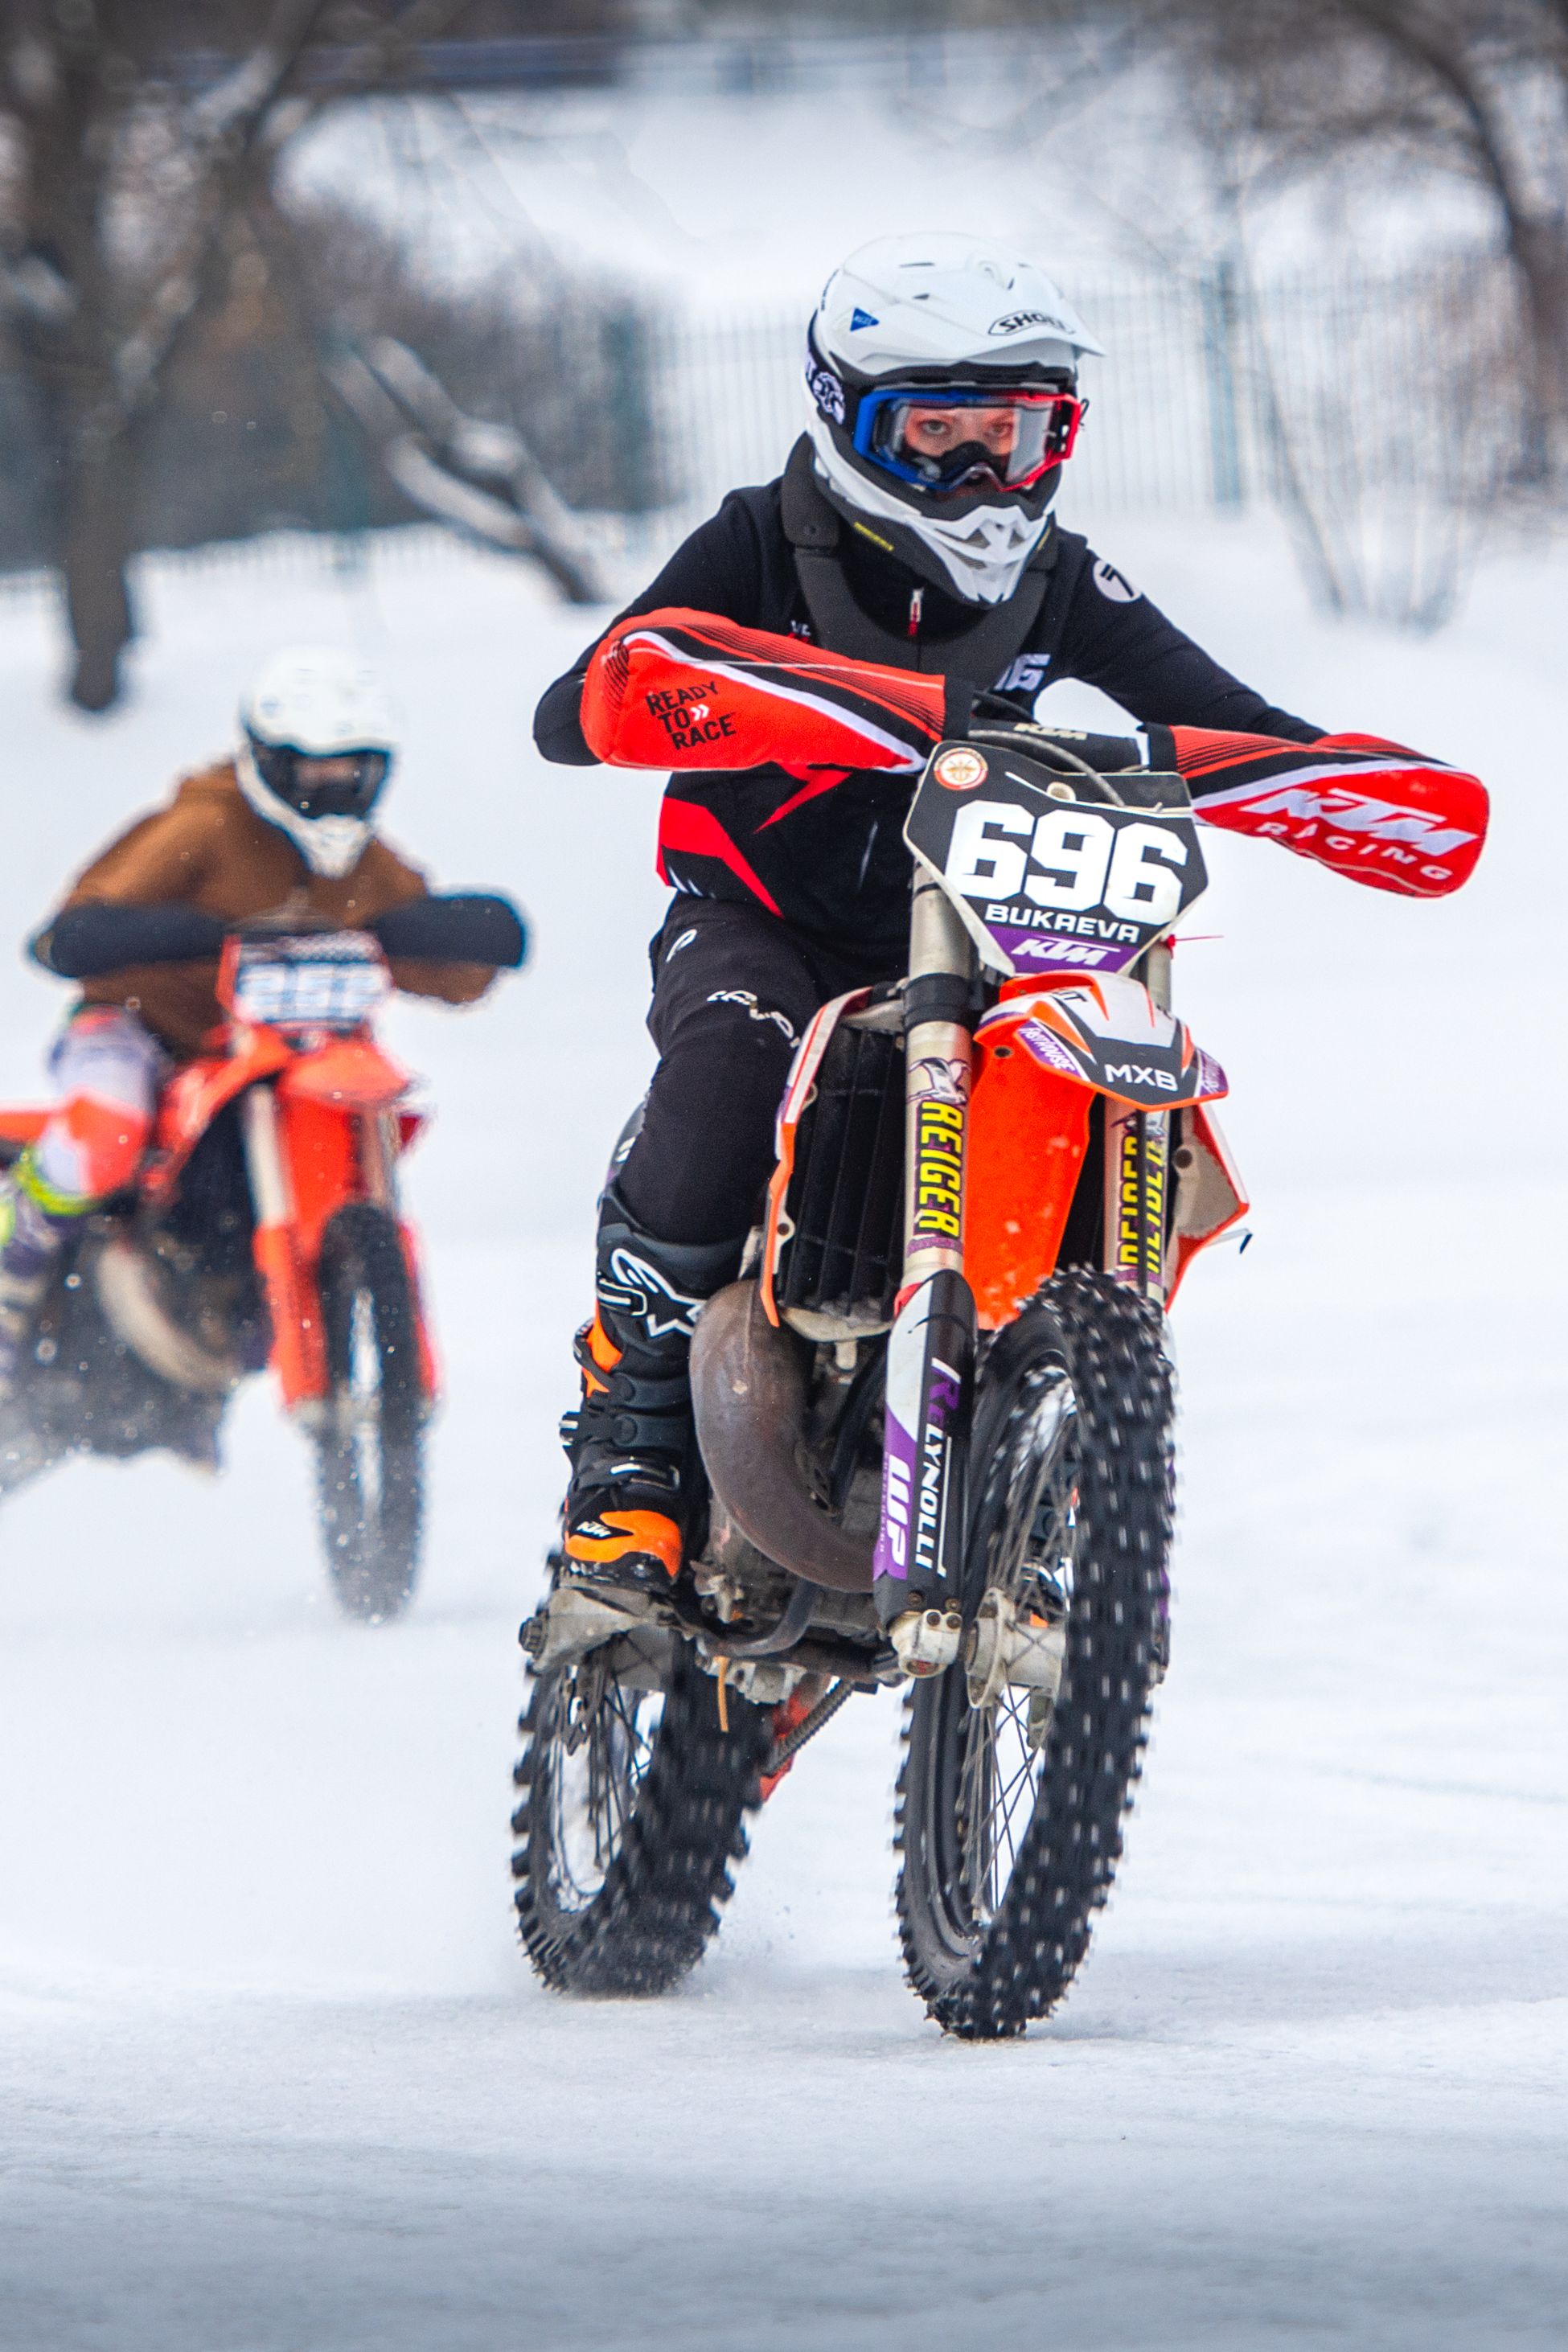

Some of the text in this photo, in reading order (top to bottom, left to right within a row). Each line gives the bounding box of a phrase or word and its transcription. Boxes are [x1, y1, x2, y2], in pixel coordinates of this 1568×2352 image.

[645, 681, 718, 716] READY
[658, 708, 691, 733] TO
[671, 712, 736, 749] RACE
[1238, 788, 1477, 856] KTM
[945, 799, 1188, 926] 696
[1255, 821, 1452, 880] RACING
[985, 904, 1139, 943] BUKAEVA
[1011, 934, 1121, 966] KTM
[1104, 1064, 1179, 1092] MXB
[919, 1101, 963, 1238] REIGER
[887, 1454, 910, 1566] WP
